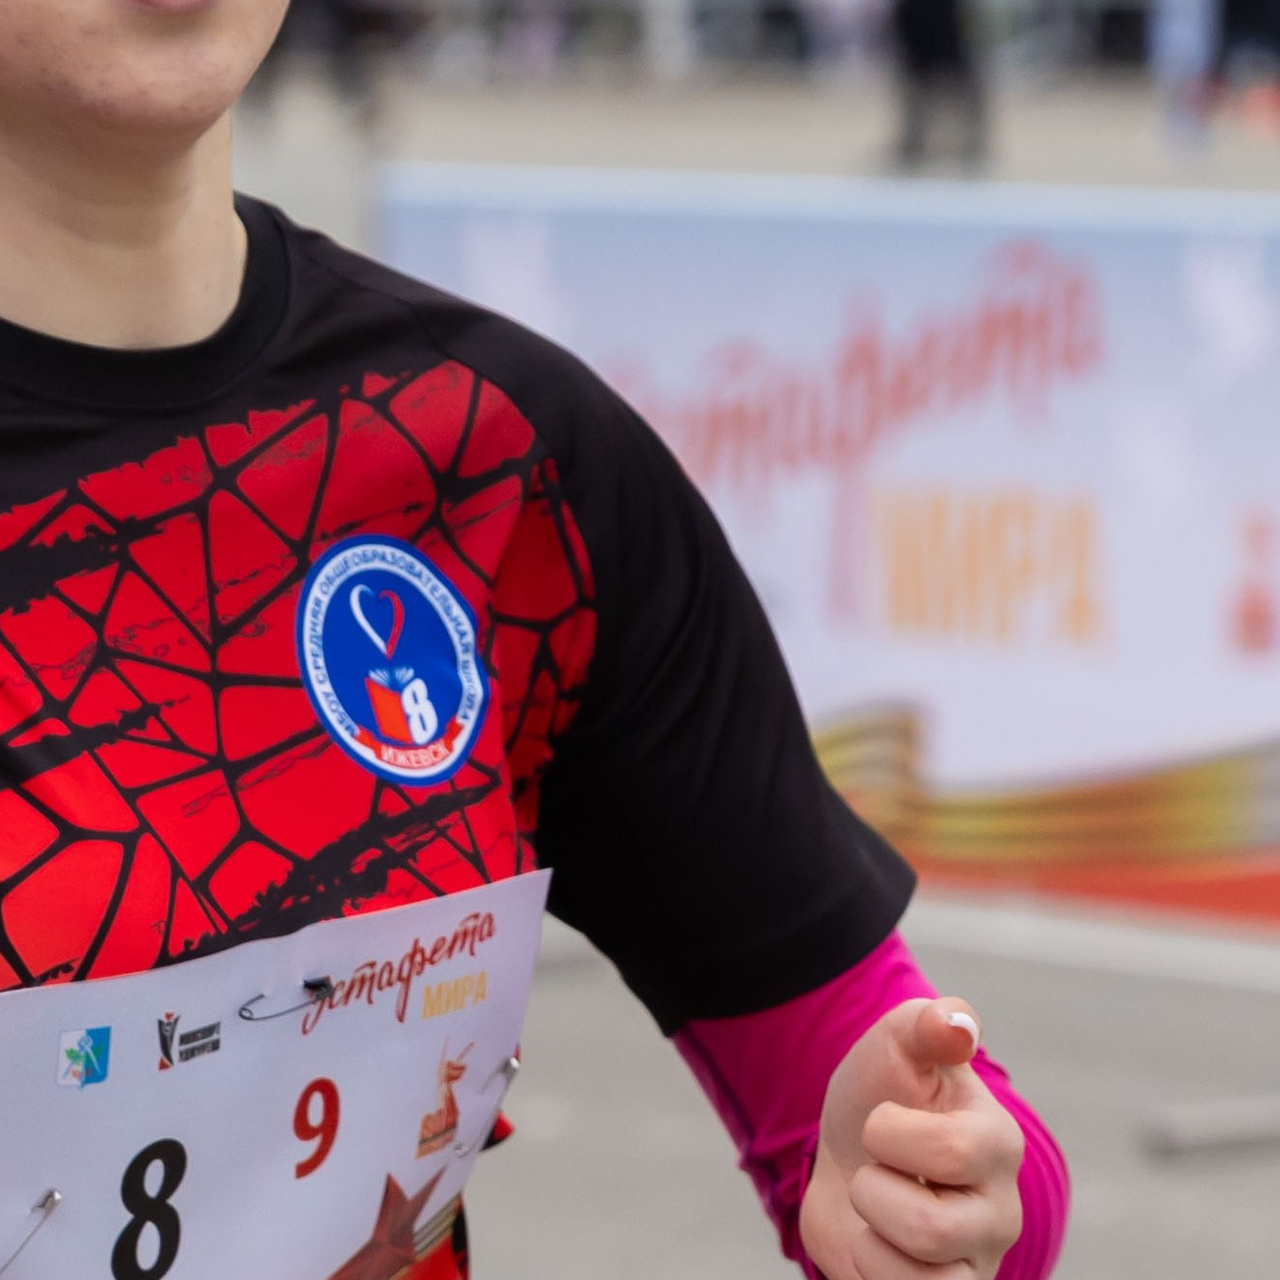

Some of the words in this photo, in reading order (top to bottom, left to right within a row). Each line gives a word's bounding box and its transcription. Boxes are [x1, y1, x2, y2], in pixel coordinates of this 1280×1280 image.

[308, 596, 329, 686] СРЕДНЯЯ
[321, 548, 470, 662] ОБЩЕОБРАЗОВАТЕЛЬНАЯ
[401, 678, 438, 745] 8
[380, 738, 450, 768] ИЖЕВСК
[422, 971, 487, 1019] МИРА
[293, 1077, 340, 1179] 9
